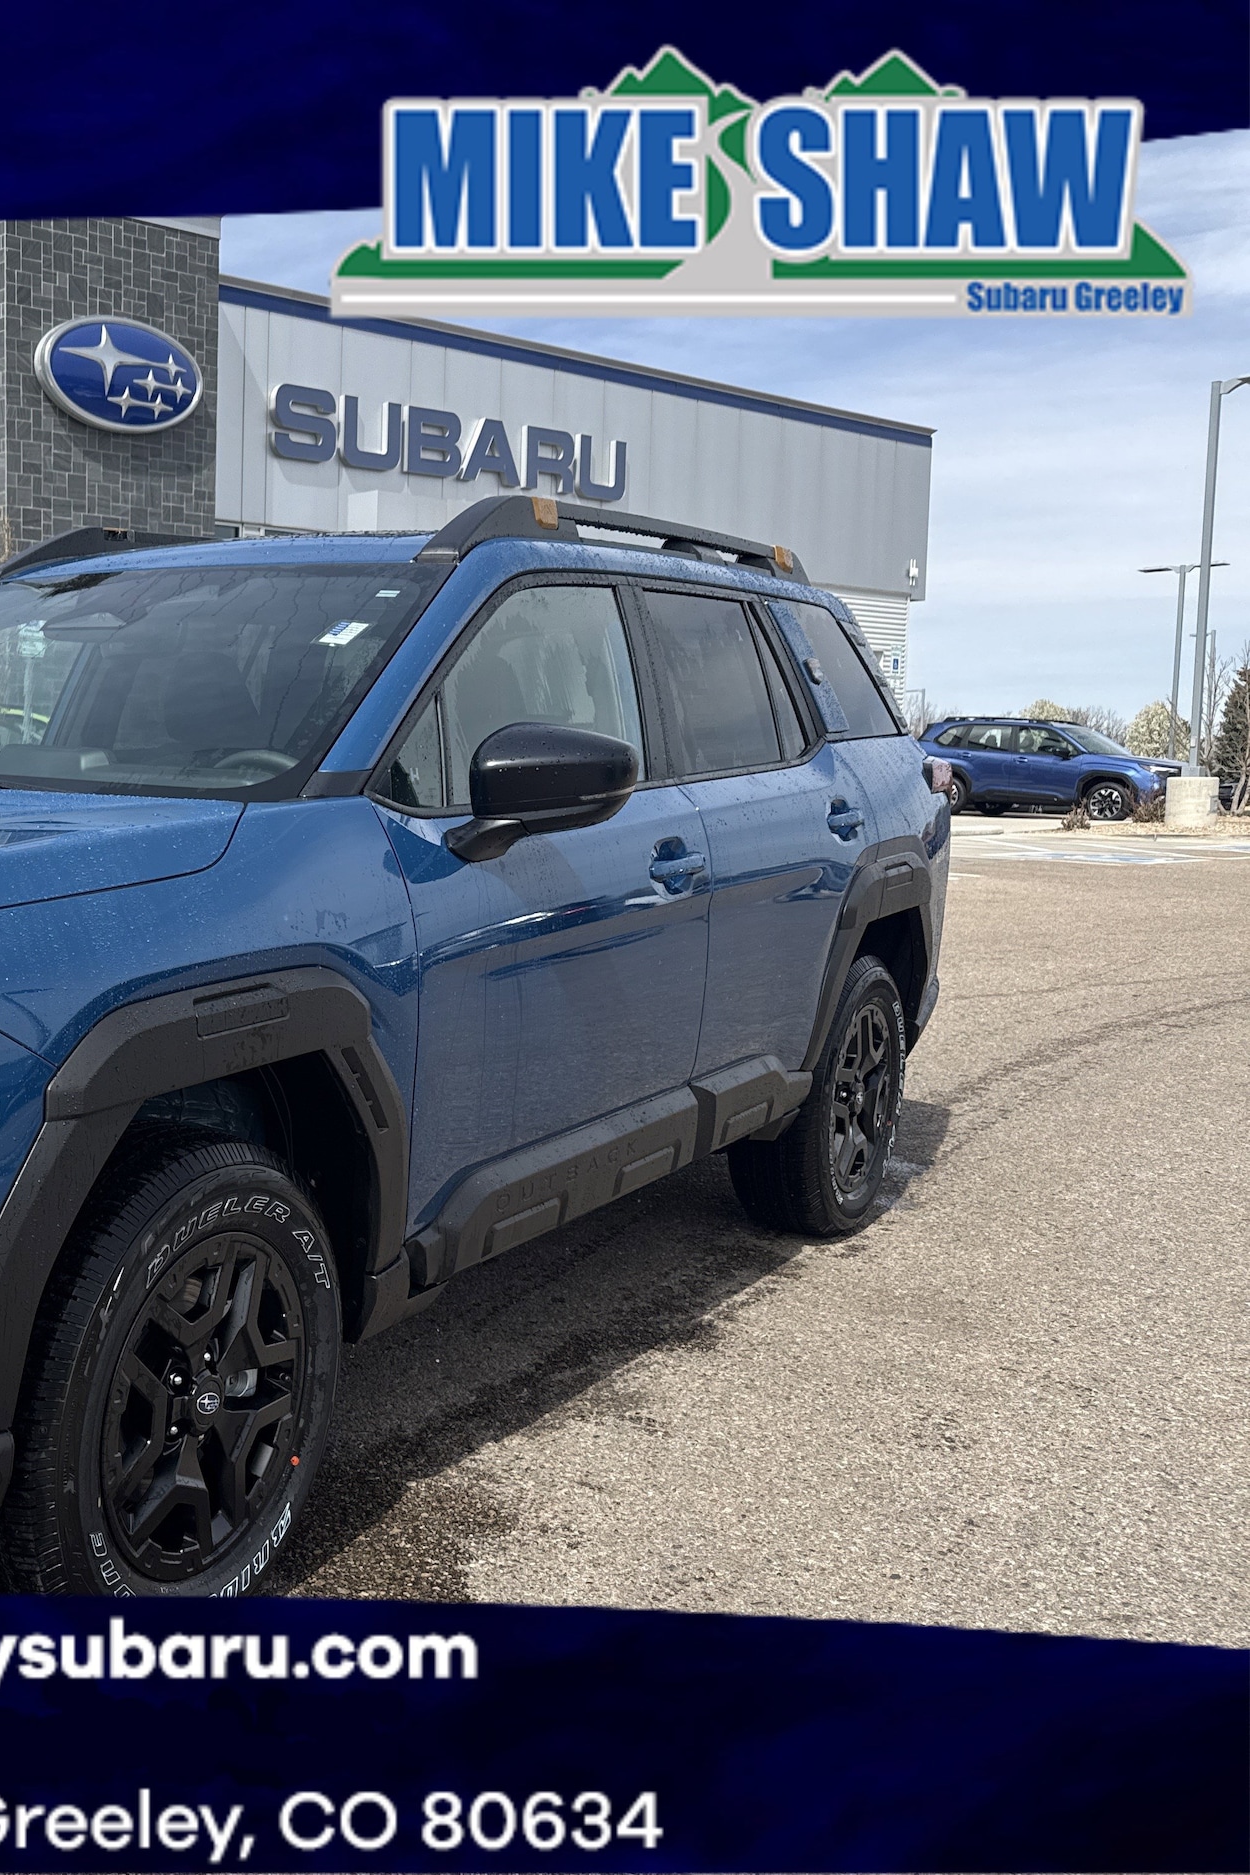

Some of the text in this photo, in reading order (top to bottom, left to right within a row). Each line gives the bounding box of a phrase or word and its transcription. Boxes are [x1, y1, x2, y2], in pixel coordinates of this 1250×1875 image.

[270, 381, 628, 501] SUBARU
[496, 1138, 639, 1213] OUTBACK
[145, 1195, 291, 1289] DUELER
